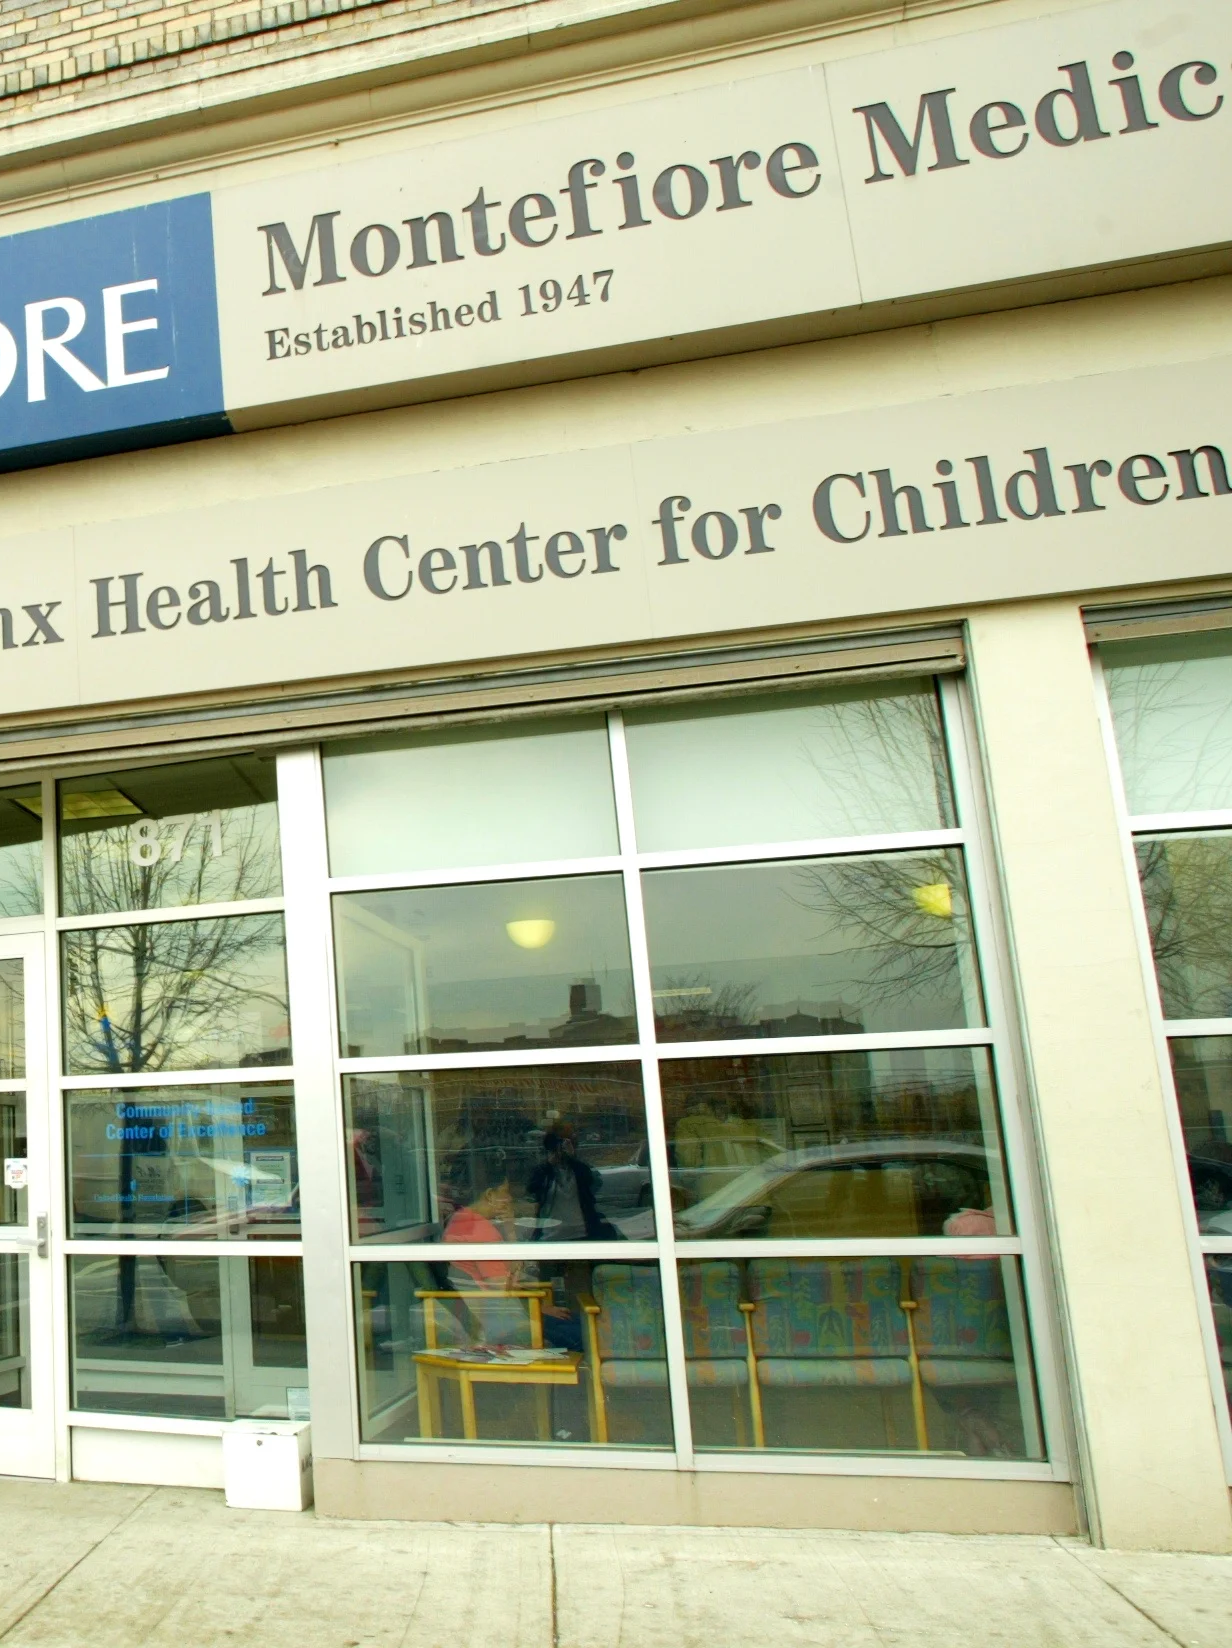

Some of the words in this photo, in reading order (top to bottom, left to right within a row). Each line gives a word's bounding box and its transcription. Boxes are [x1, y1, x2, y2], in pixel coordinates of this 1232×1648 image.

[257, 140, 822, 297] Montefiore
[851, 50, 1232, 185] Medic
[264, 289, 503, 361] Established
[518, 268, 615, 317] 1947
[89, 548, 339, 639] Health
[363, 521, 628, 602] Center
[651, 495, 782, 567] for
[812, 444, 1232, 544] Children
[129, 808, 223, 867] 871
[105, 1123, 155, 1140] Center
[159, 1121, 175, 1138] of
